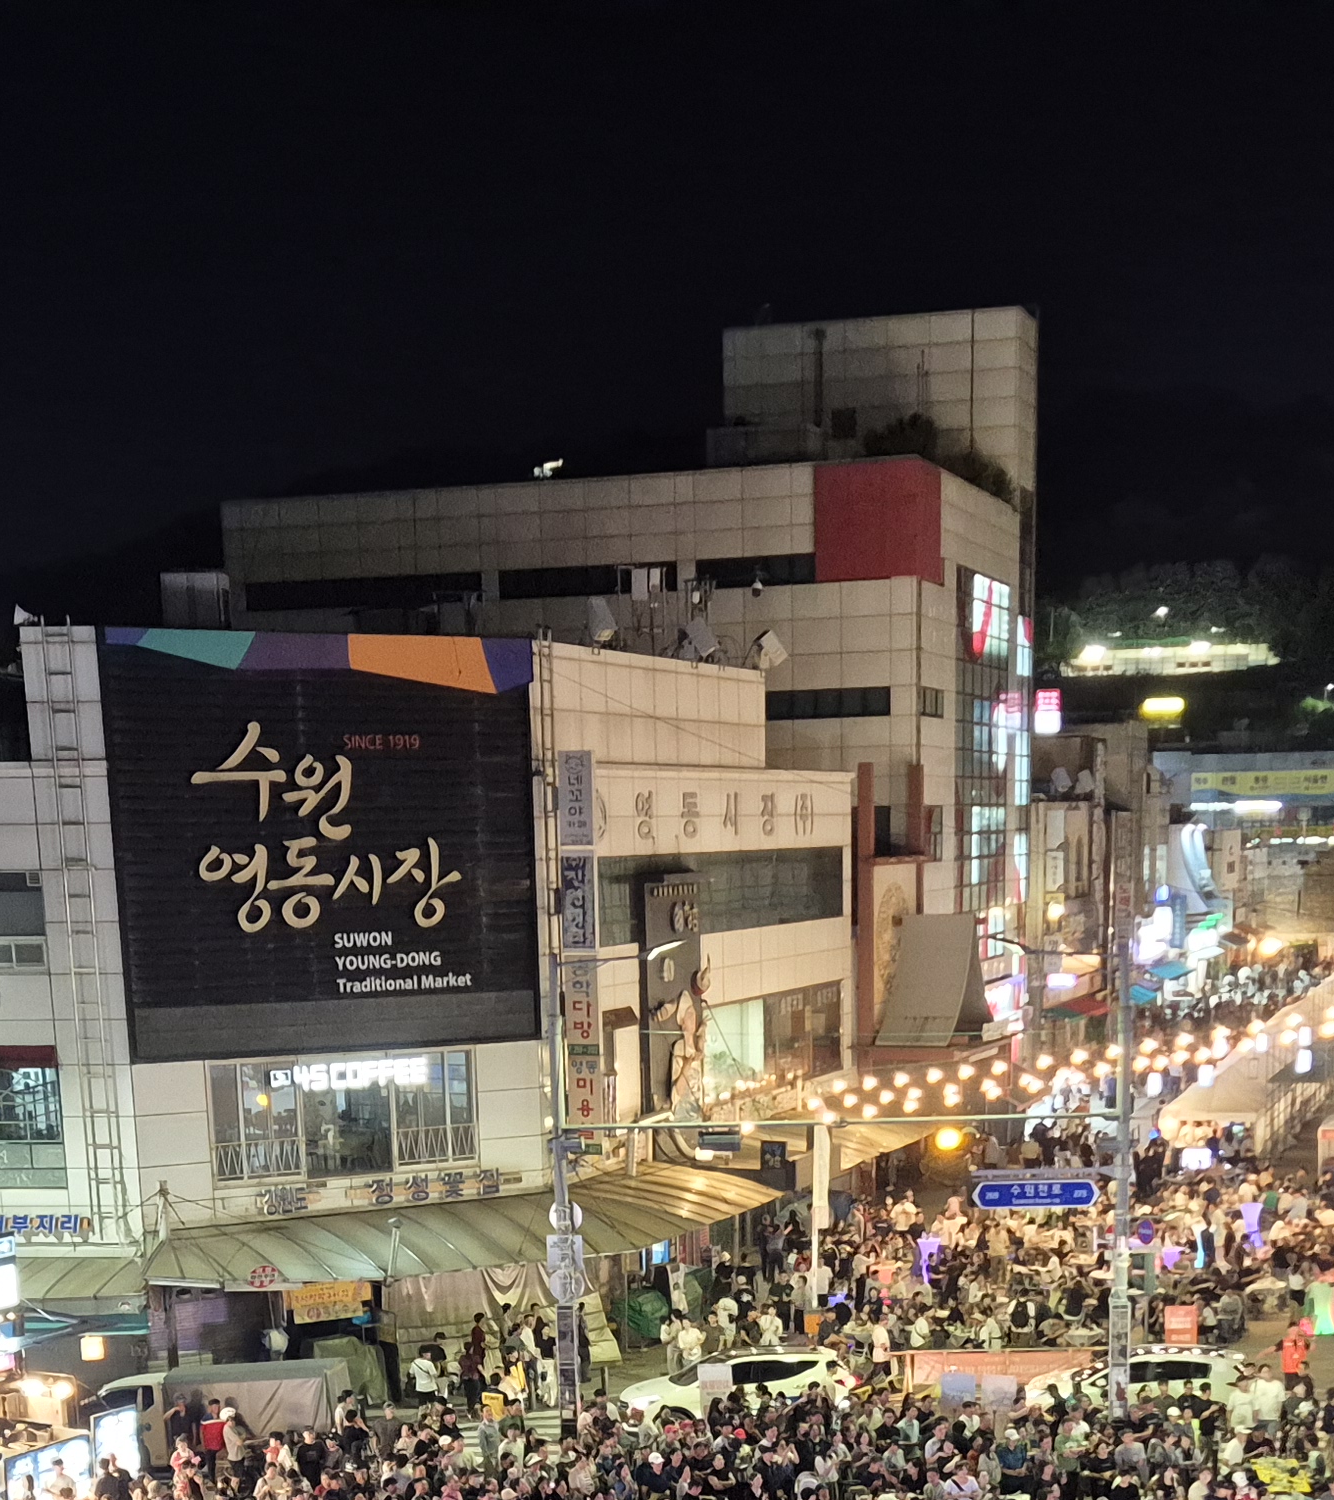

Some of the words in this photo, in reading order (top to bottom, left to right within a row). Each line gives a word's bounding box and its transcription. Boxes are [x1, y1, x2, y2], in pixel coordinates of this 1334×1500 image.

[343, 734, 383, 750] SINCE
[388, 734, 420, 750] 1919
[190, 720, 353, 840] 수원
[198, 836, 463, 933] 영동시장
[334, 931, 393, 949] SUWON
[335, 951, 442, 971] YOUNG-DONG
[336, 974, 417, 994] Traditional
[420, 971, 472, 990] Market
[329, 1057, 428, 1090] COFFEE
